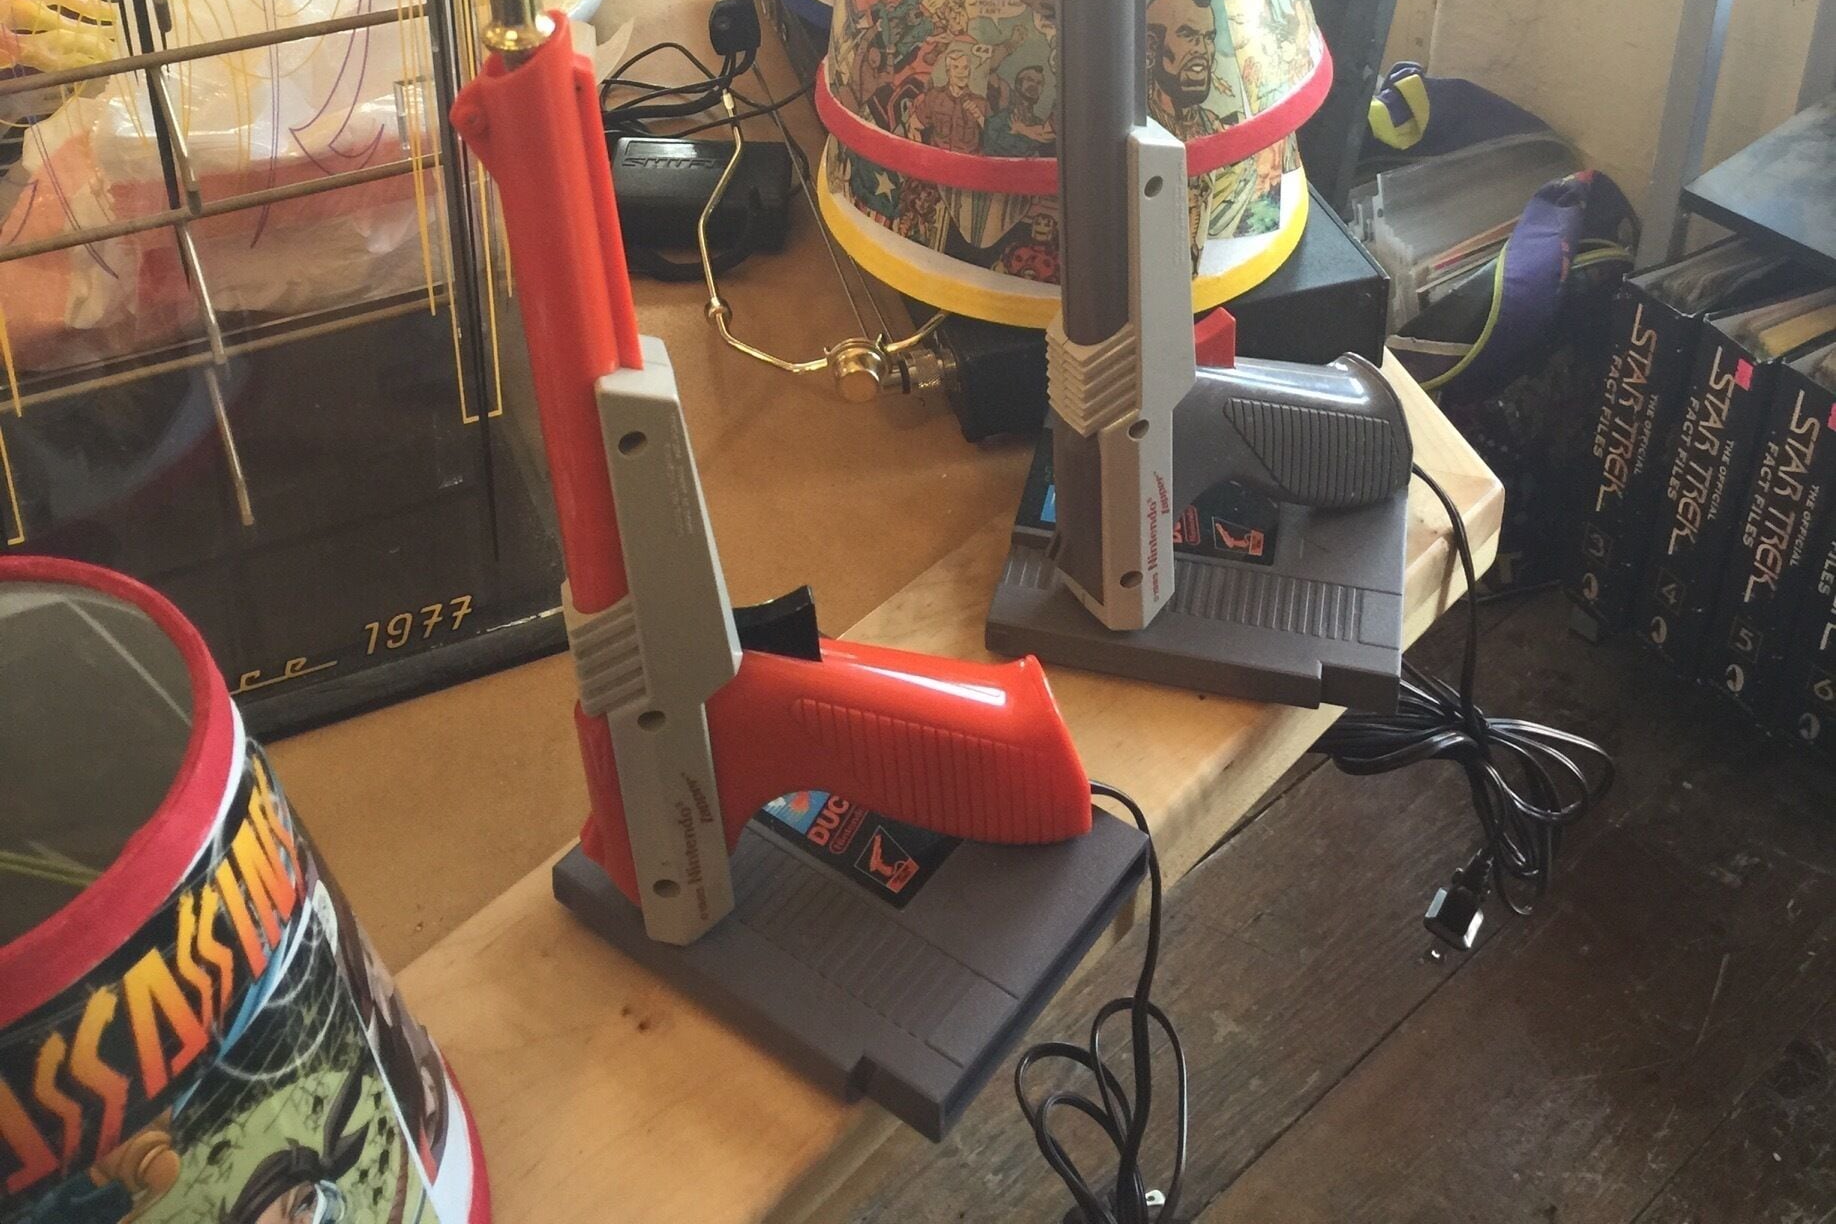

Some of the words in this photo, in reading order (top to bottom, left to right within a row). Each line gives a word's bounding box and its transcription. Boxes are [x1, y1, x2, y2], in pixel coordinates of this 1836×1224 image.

[1604, 353, 1623, 404] FACT
[1618, 303, 1657, 413] STAR
[1647, 393, 1659, 419] THE
[1680, 395, 1700, 447] FACT
[1694, 345, 1737, 457] STAR
[1592, 405, 1613, 458] FILES
[1634, 419, 1652, 474] OFFICIAL
[1722, 439, 1735, 464] THE
[1773, 389, 1821, 502] STAR
[1595, 413, 1639, 512] TREK
[1666, 447, 1688, 500] FILES
[1758, 440, 1780, 494] FACT
[1667, 459, 1713, 556] TREK
[1707, 464, 1728, 520] OFFICIAL
[1806, 483, 1820, 510] THE
[1147, 501, 1158, 571] Nintendo
[1742, 495, 1765, 549] FILES
[1789, 510, 1811, 566] OFFICIAL
[1743, 505, 1796, 603] TREK
[364, 594, 473, 656] 1977
[678, 806, 703, 885] Nintendo
[806, 795, 849, 846] DUC
